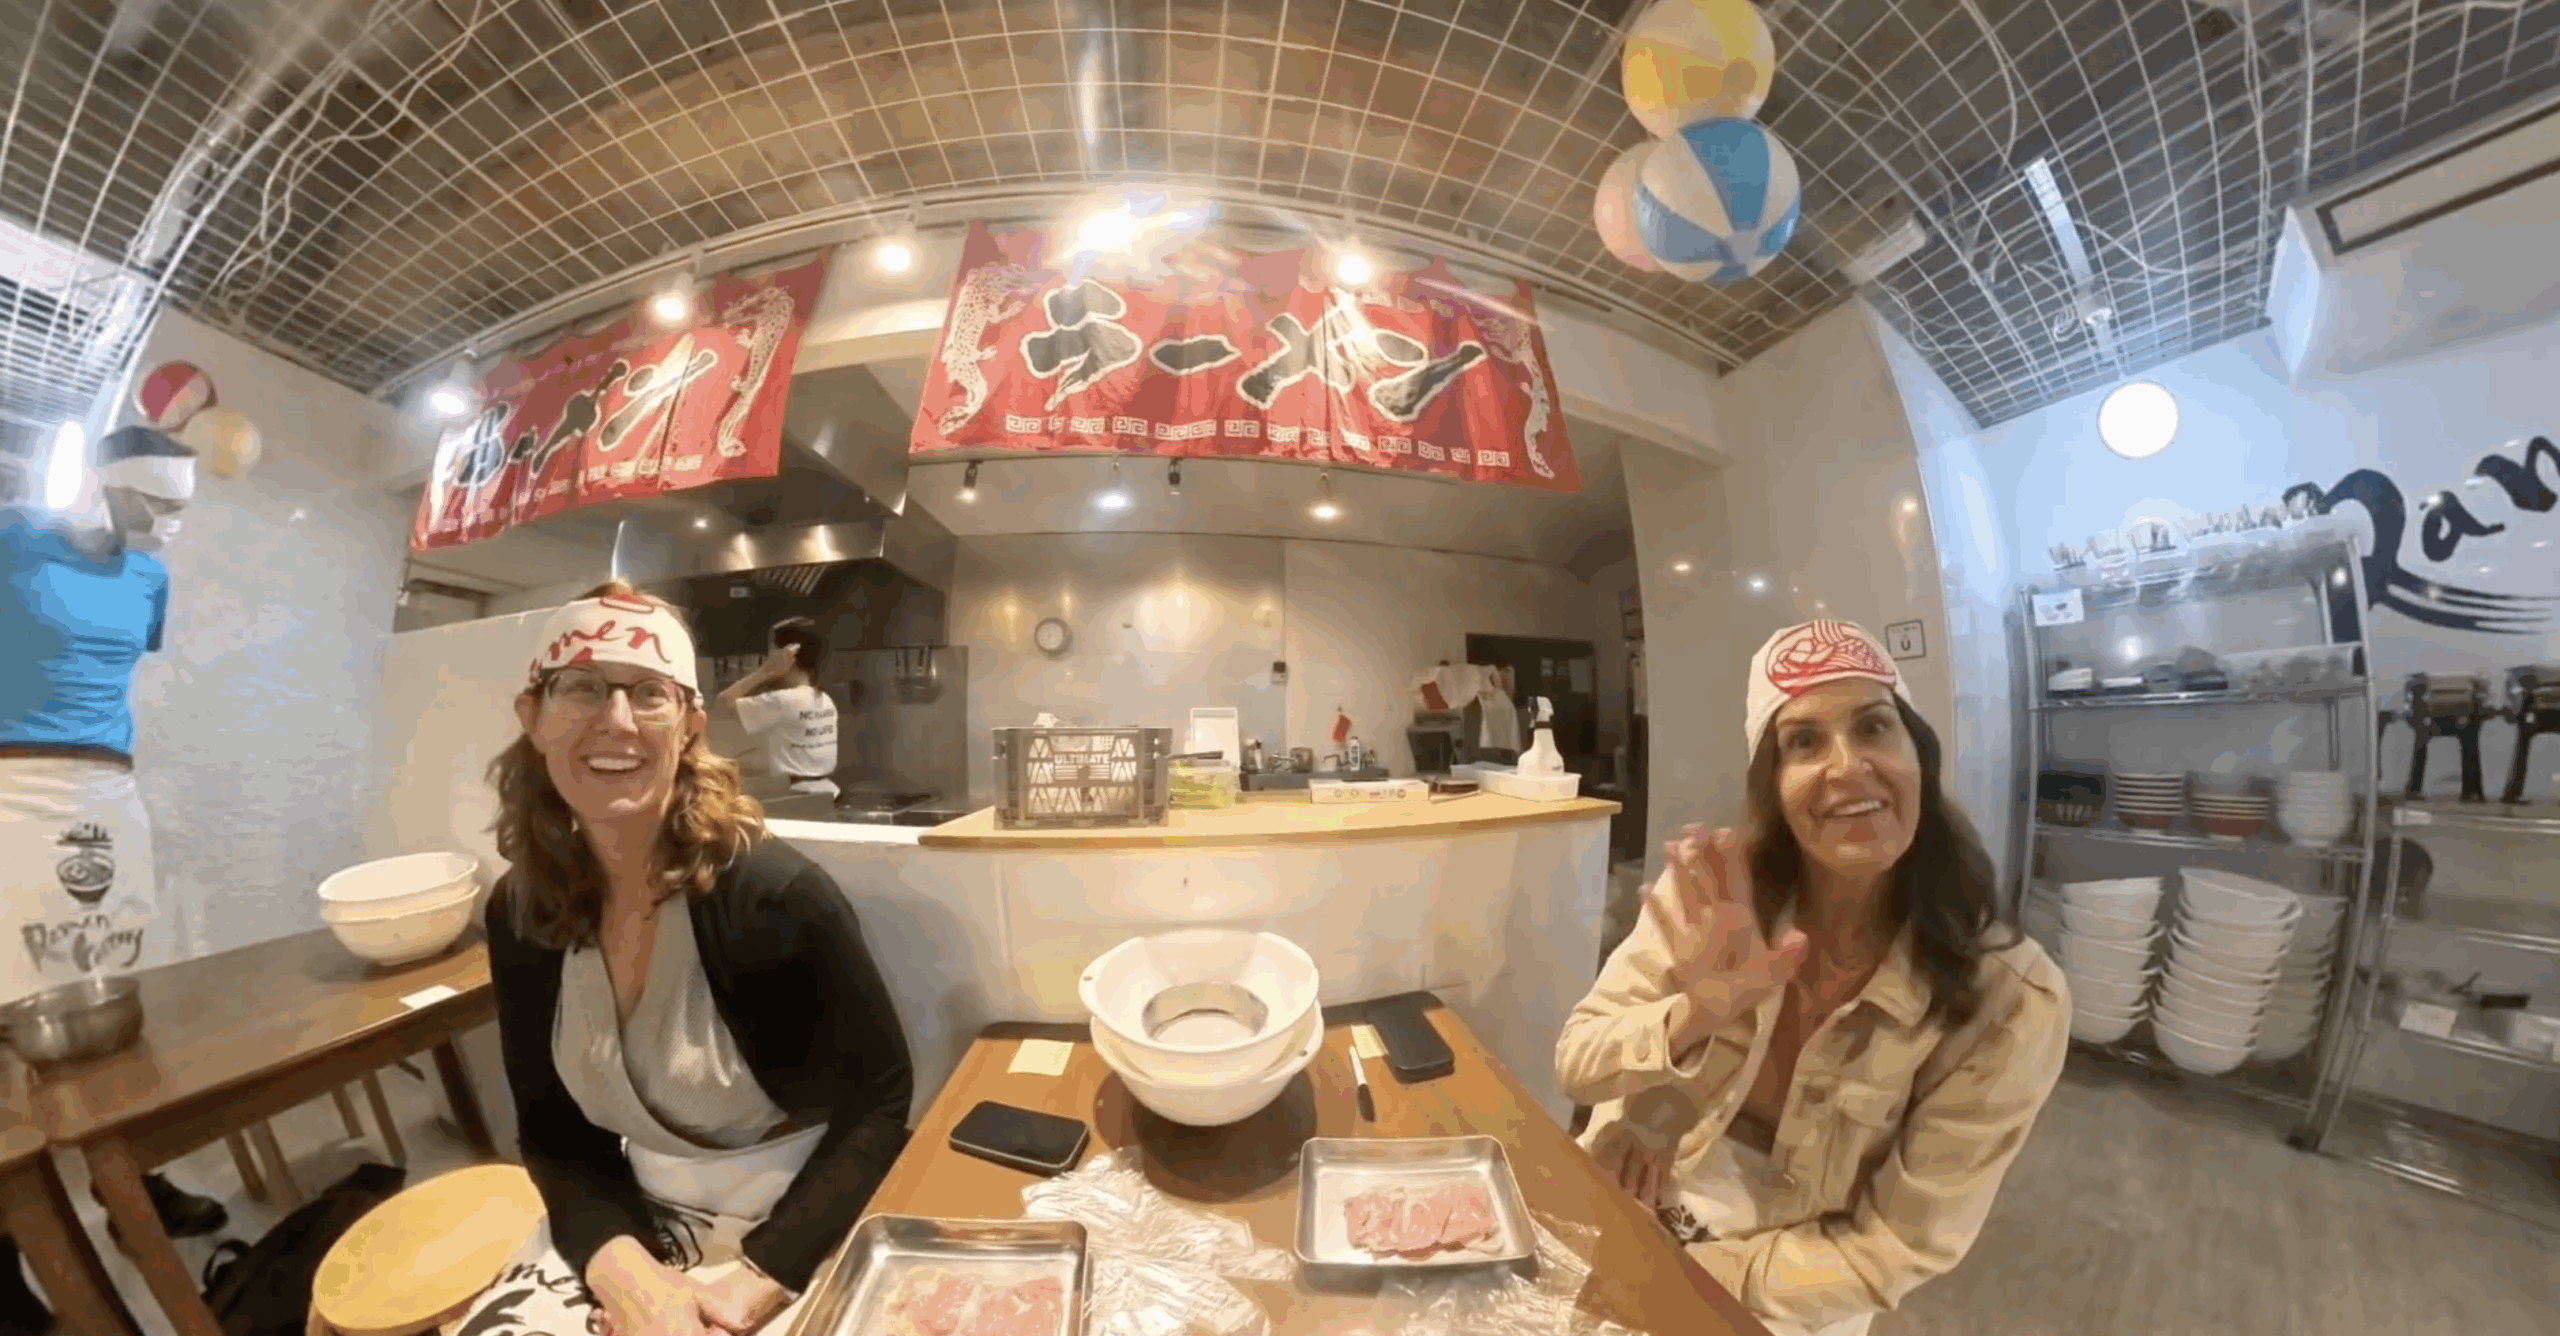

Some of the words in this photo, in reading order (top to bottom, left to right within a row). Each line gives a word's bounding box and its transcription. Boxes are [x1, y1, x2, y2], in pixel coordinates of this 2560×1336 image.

[1020, 278, 1489, 421] ラーメン
[1054, 753, 1110, 764] ULTIMATE
